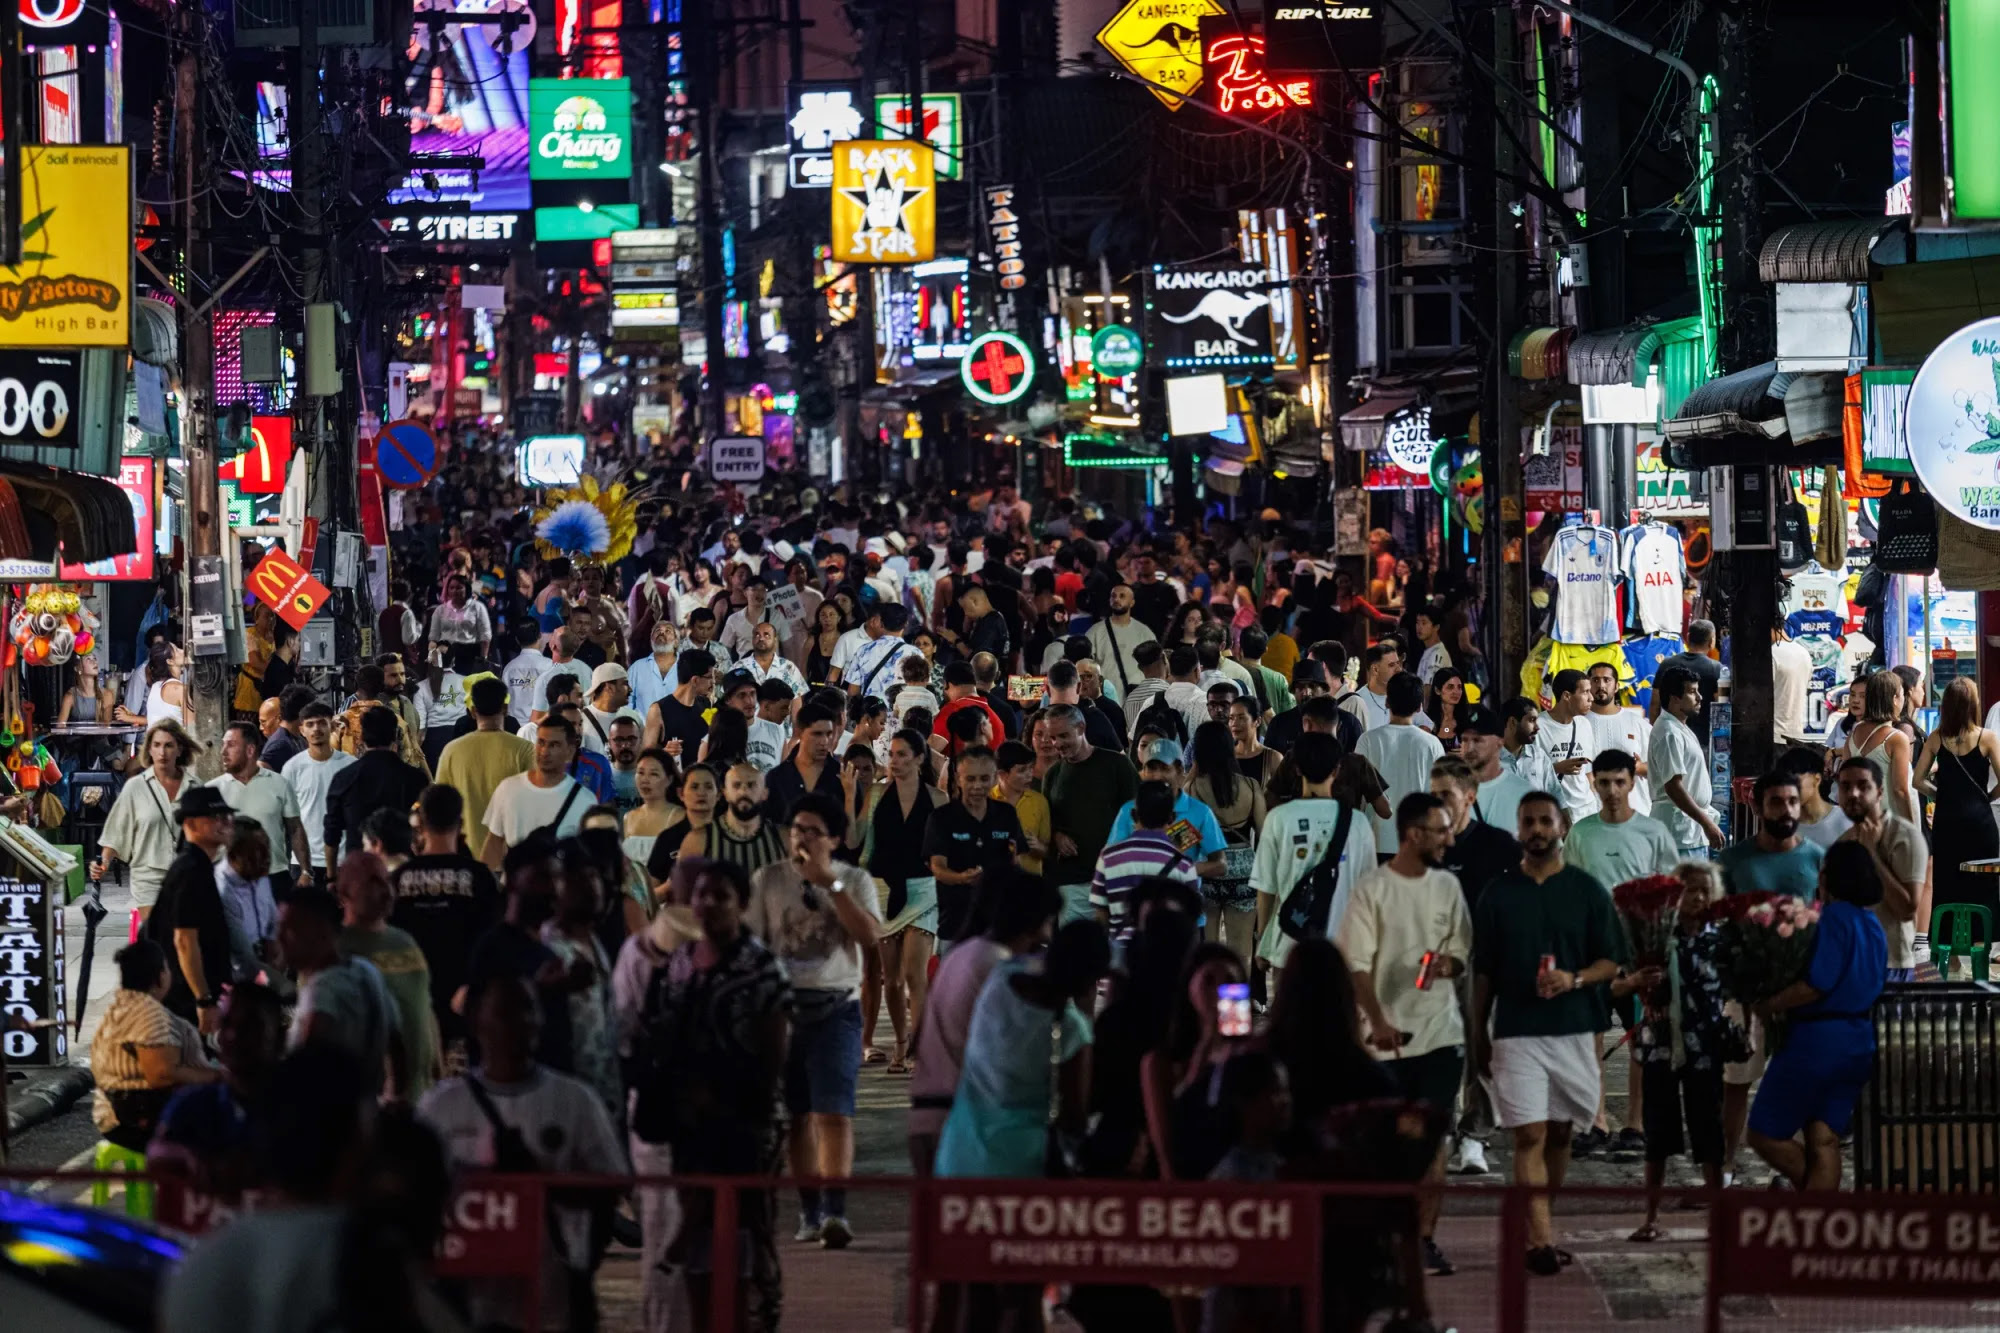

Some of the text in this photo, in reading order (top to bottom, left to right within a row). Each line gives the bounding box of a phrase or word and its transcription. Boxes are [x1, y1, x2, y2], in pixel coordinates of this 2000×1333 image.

[1138, 4, 1205, 19] KANGAROO
[1159, 69, 1188, 83] BAR
[539, 132, 622, 161] Chang
[418, 215, 518, 240] STREET
[850, 231, 917, 260] STAR
[987, 190, 1026, 290] TATTOO
[28, 281, 112, 305] Factory
[35, 317, 118, 333] High Bar
[1195, 340, 1239, 357] BAR
[720, 447, 755, 458] FREE
[716, 460, 761, 472] ENTRY
[1567, 571, 1602, 582] Betano
[1644, 571, 1673, 586] AIA
[1802, 589, 1827, 599] MBAPPE
[1801, 622, 1831, 631] MBAPPE
[1807, 681, 1824, 689] ESSI
[940, 1196, 1292, 1239] PATONG BEACH
[1739, 1208, 1931, 1249] PATONG
[991, 1241, 1238, 1269] PHUKET THAILAND
[1791, 1256, 1897, 1280] PHUKET
